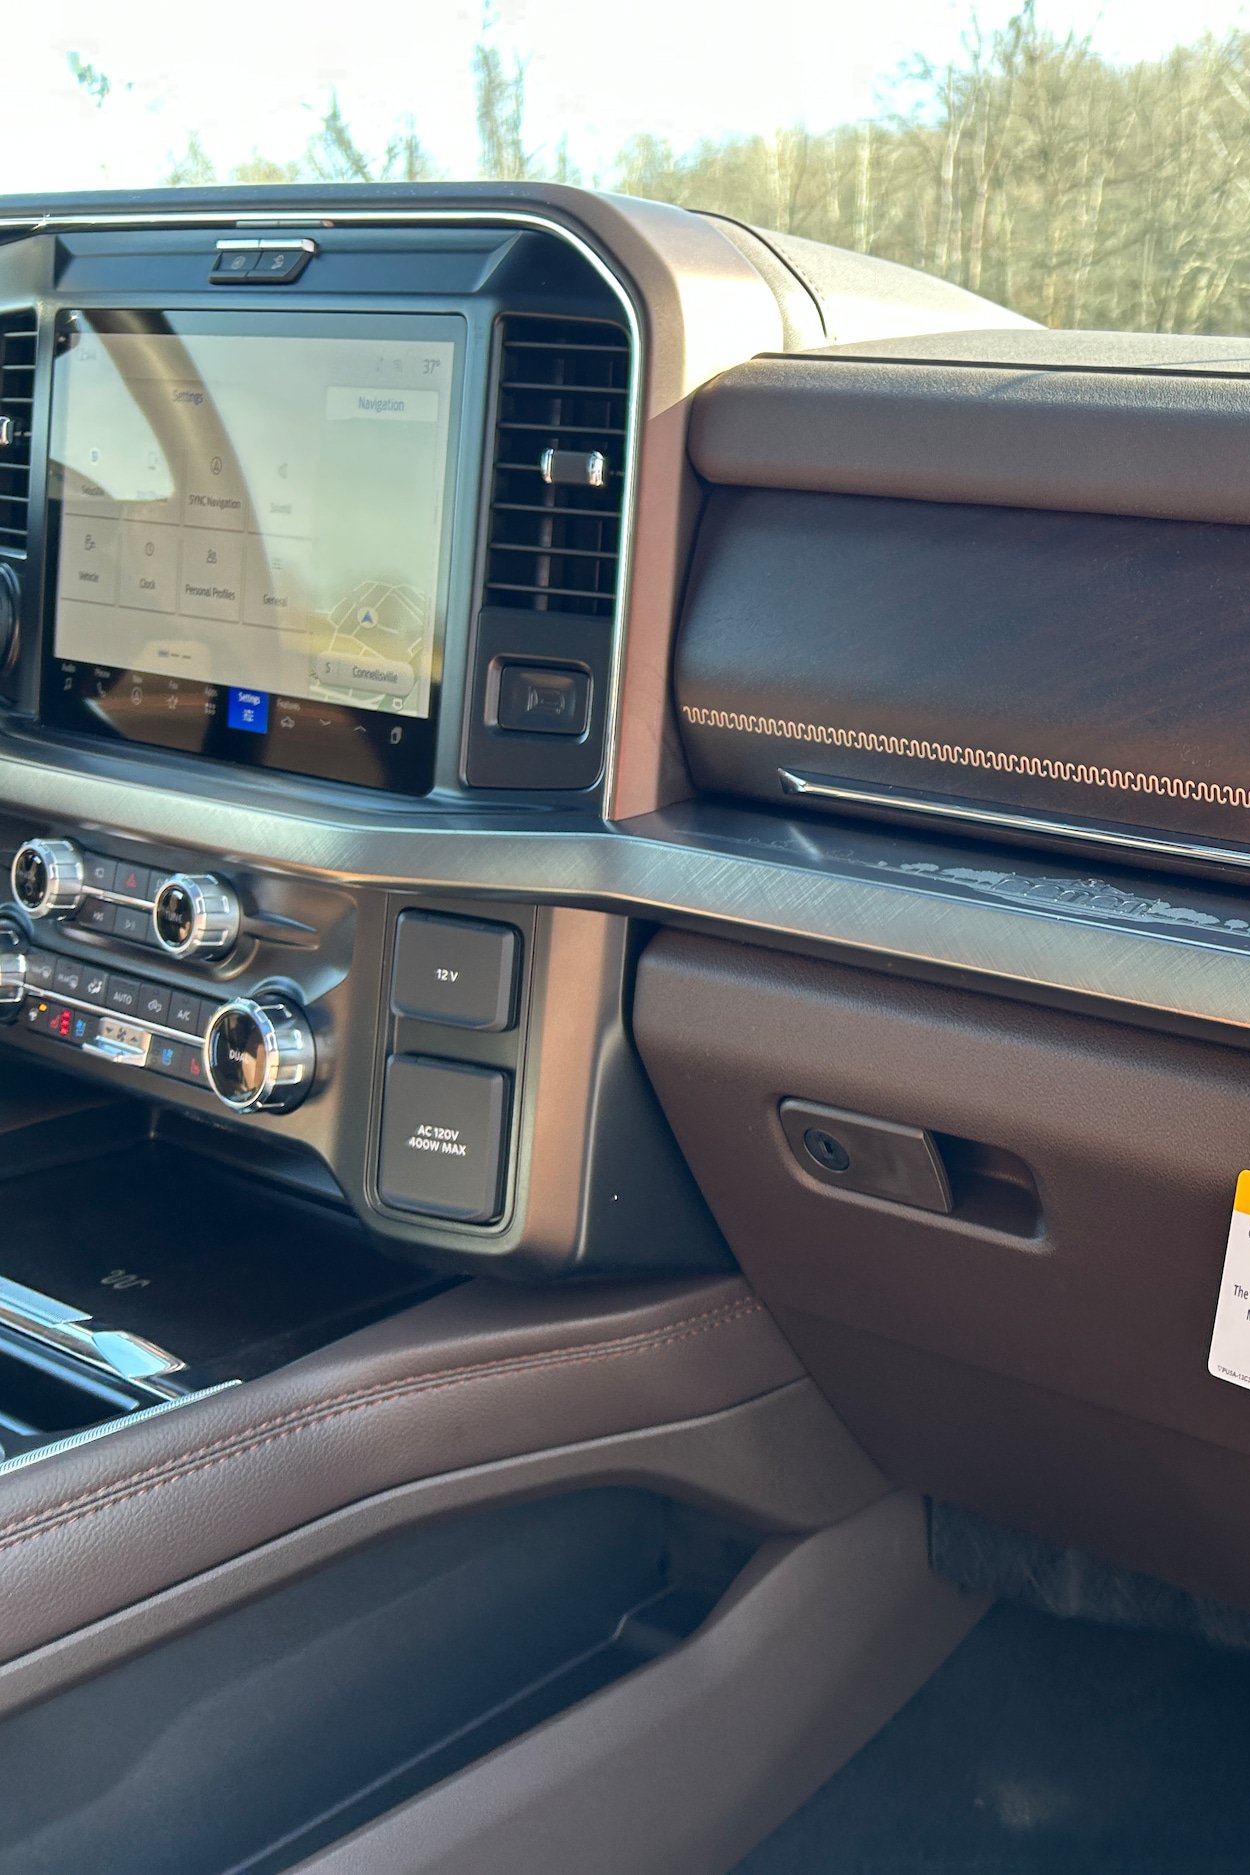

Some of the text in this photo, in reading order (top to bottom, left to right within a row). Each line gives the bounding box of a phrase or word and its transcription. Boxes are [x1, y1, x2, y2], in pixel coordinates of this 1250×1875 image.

[358, 396, 405, 413] Navigation
[185, 583, 211, 597] Personal
[436, 968, 459, 982] 12 V
[113, 991, 133, 1005] AUTO
[176, 1009, 191, 1022] A/C
[417, 1124, 460, 1141] AC 120V
[408, 1136, 467, 1156] 400W MAX
[1233, 1284, 1249, 1300] The
